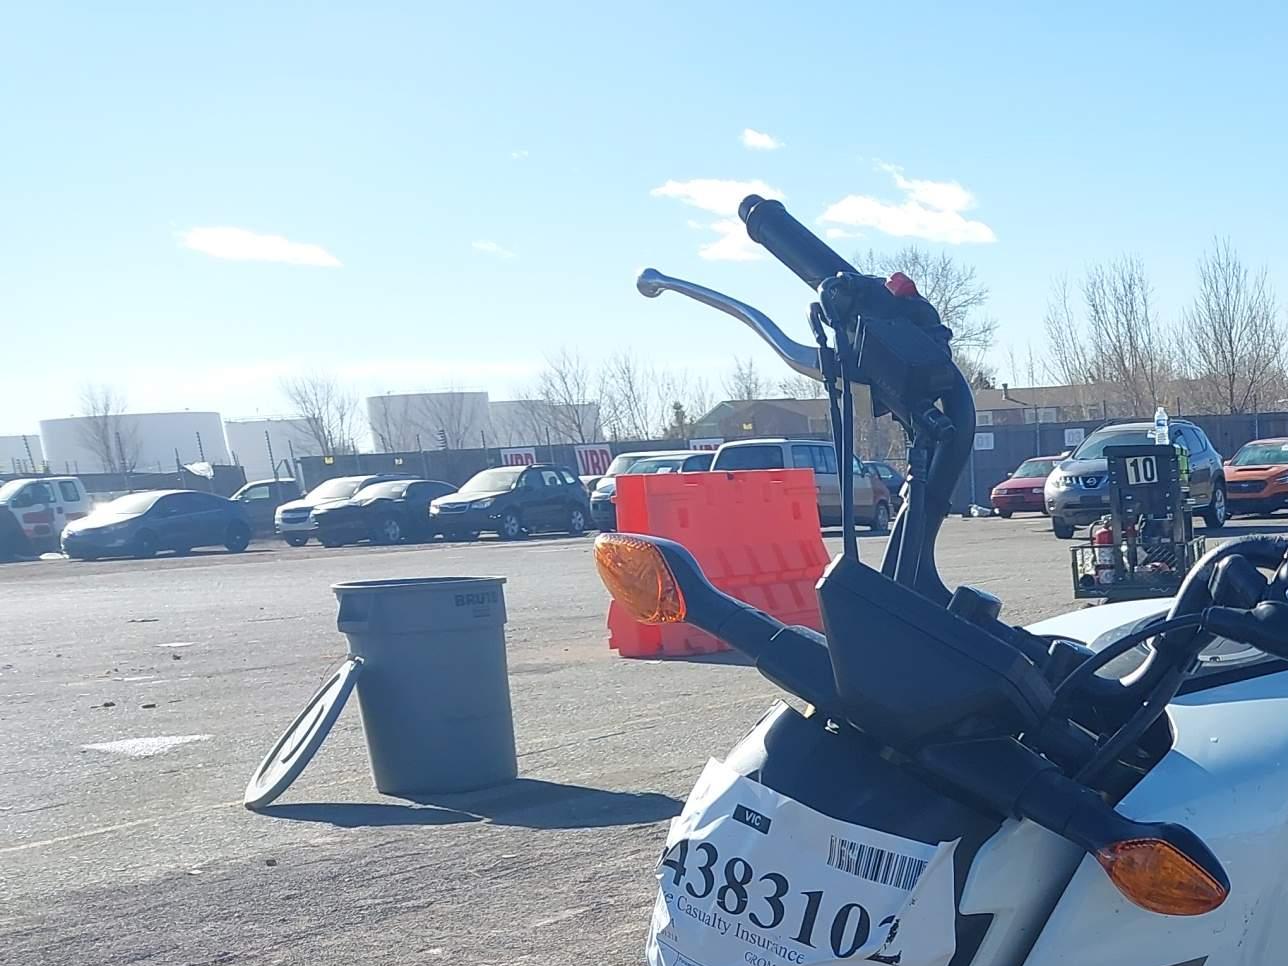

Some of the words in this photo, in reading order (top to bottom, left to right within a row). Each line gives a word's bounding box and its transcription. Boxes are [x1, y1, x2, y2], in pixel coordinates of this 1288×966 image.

[1130, 458, 1155, 483] 10
[744, 809, 762, 827] VIC
[677, 894, 732, 936] Casualty
[734, 922, 805, 965] Insurance
